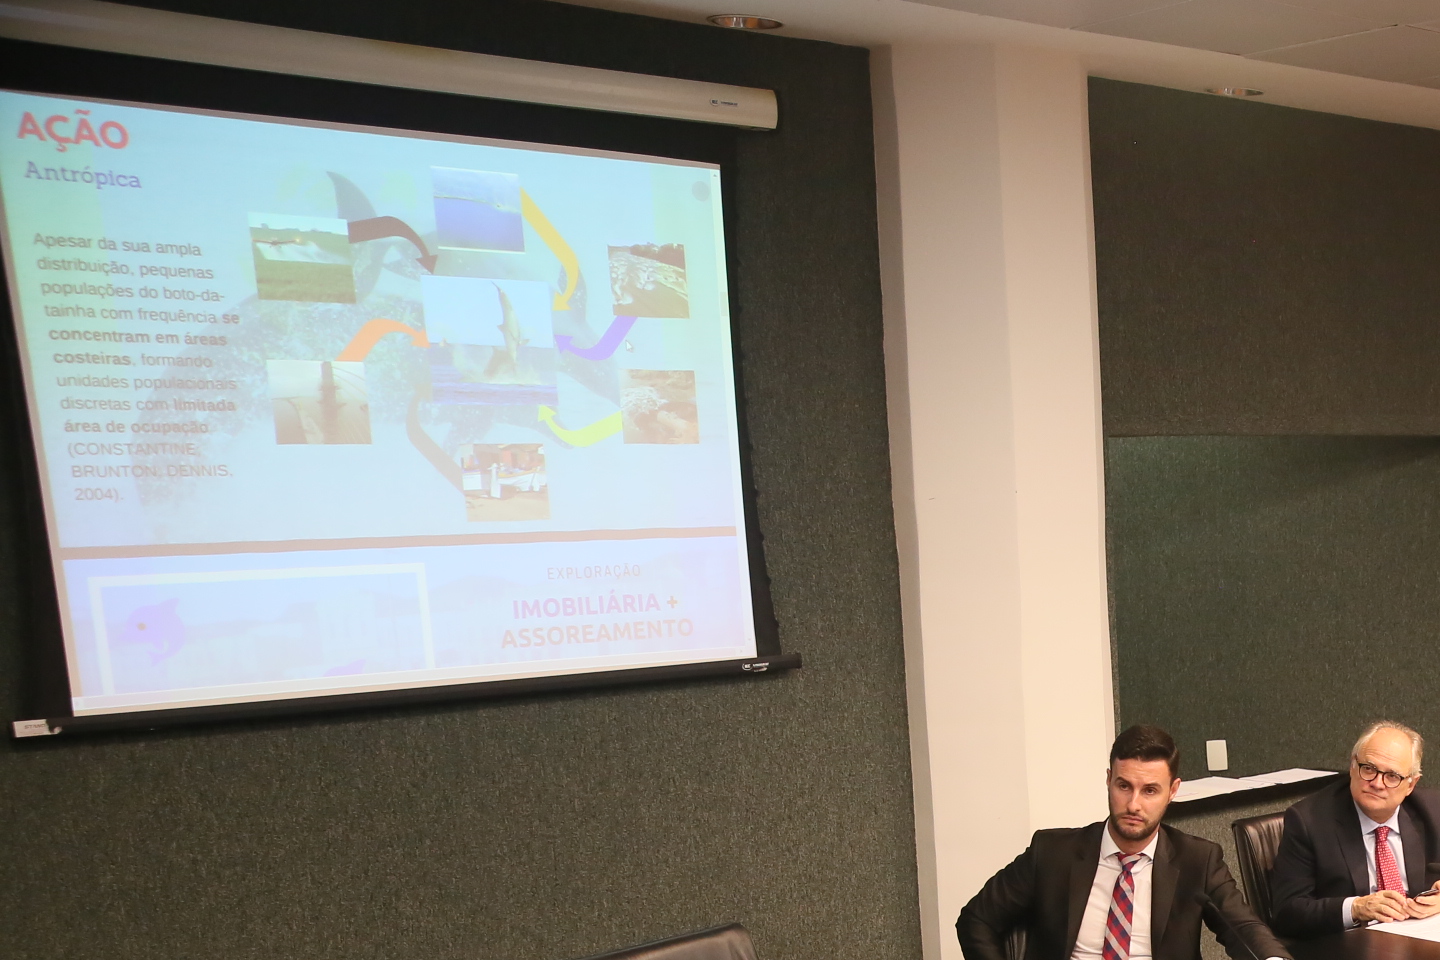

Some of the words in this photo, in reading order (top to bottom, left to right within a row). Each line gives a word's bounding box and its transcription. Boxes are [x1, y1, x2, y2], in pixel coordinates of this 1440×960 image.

[16, 108, 130, 153] AÇÃO
[23, 160, 143, 190] Antrópica
[32, 232, 92, 249] Apesar
[97, 236, 118, 251] da
[121, 241, 152, 253] sua
[155, 242, 203, 258] ampla
[36, 256, 135, 276] distribuição,
[139, 264, 215, 281] pequenas
[40, 280, 134, 301] populações
[138, 284, 159, 300] do
[163, 286, 225, 303] boto-da-
[44, 304, 96, 319] tainha
[100, 307, 134, 320] com
[137, 307, 217, 325] frequência
[222, 313, 240, 325] se
[48, 328, 150, 344] concentram
[155, 333, 180, 346] em
[184, 331, 228, 347] áreas
[141, 353, 213, 368] formando
[56, 374, 129, 390] unidades
[133, 375, 238, 392] populacionais
[60, 396, 131, 411] discretas
[135, 399, 169, 411] com
[172, 397, 237, 412] limitada
[64, 418, 102, 433] área
[105, 419, 126, 434] de
[130, 419, 209, 437] ocupação
[74, 487, 124, 503] 2004).
[547, 562, 641, 580] EXPLORAÇÃO
[512, 588, 662, 620] IMOBILIÁRIA
[501, 618, 694, 649] ASSOREAMENTO
